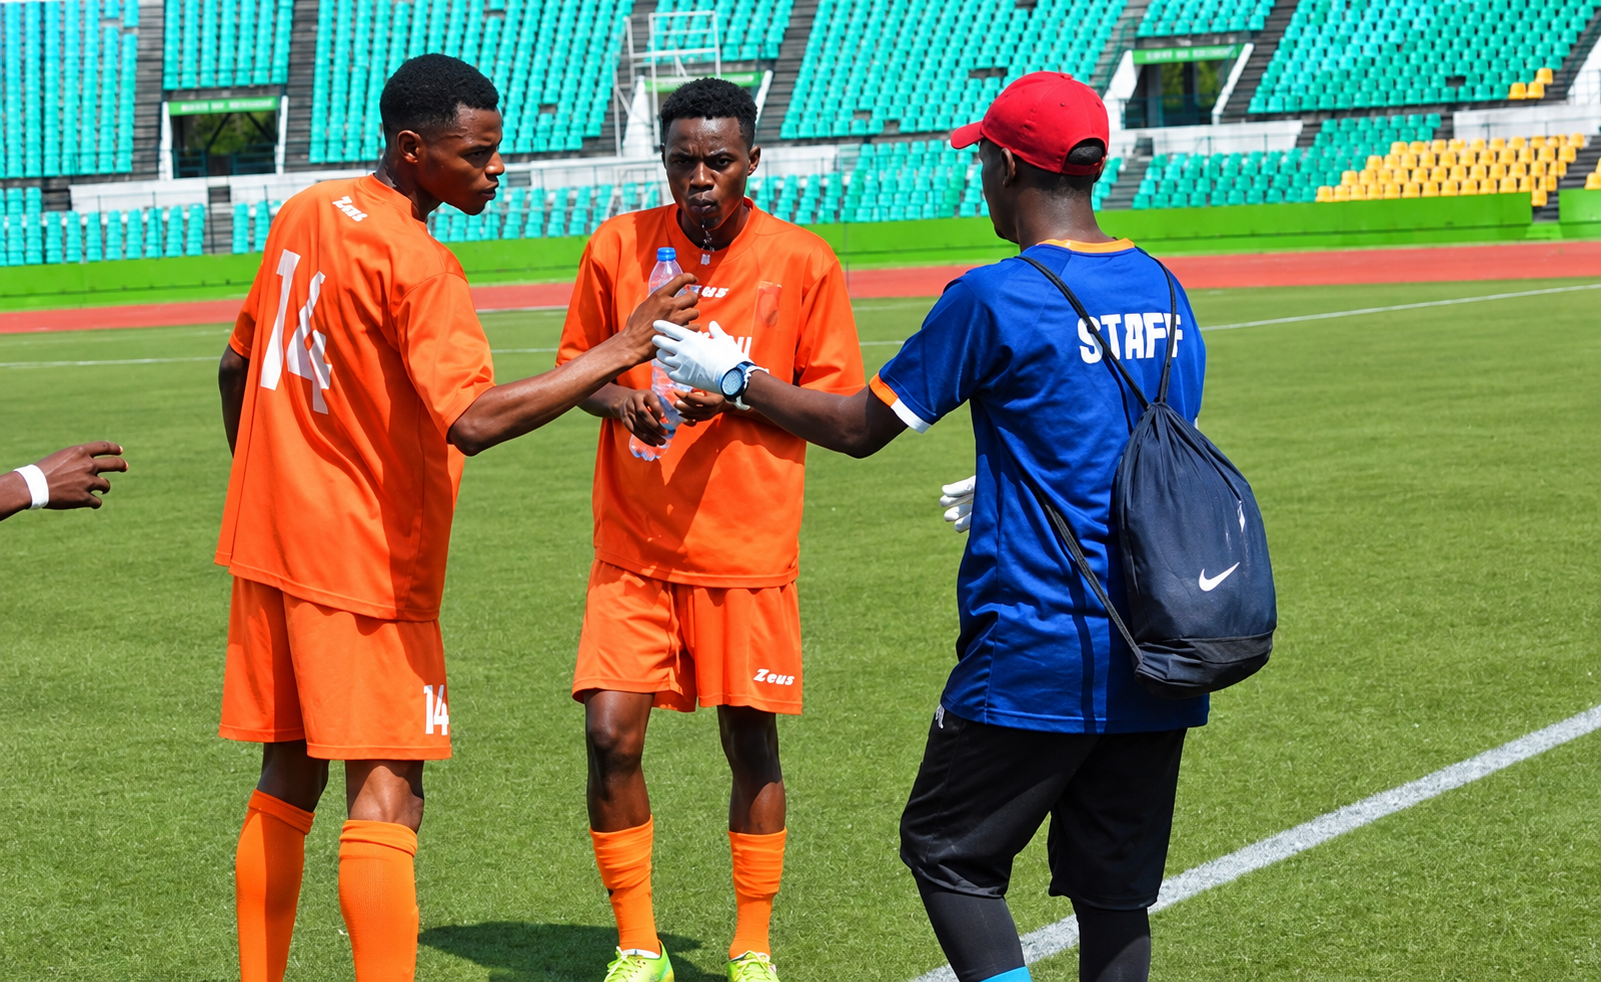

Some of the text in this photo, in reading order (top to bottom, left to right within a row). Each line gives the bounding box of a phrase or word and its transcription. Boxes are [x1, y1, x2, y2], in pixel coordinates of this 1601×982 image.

[260, 249, 332, 414] 14
[1077, 312, 1183, 364] STAFF
[753, 668, 795, 686] Zeus
[423, 684, 449, 736] 14
